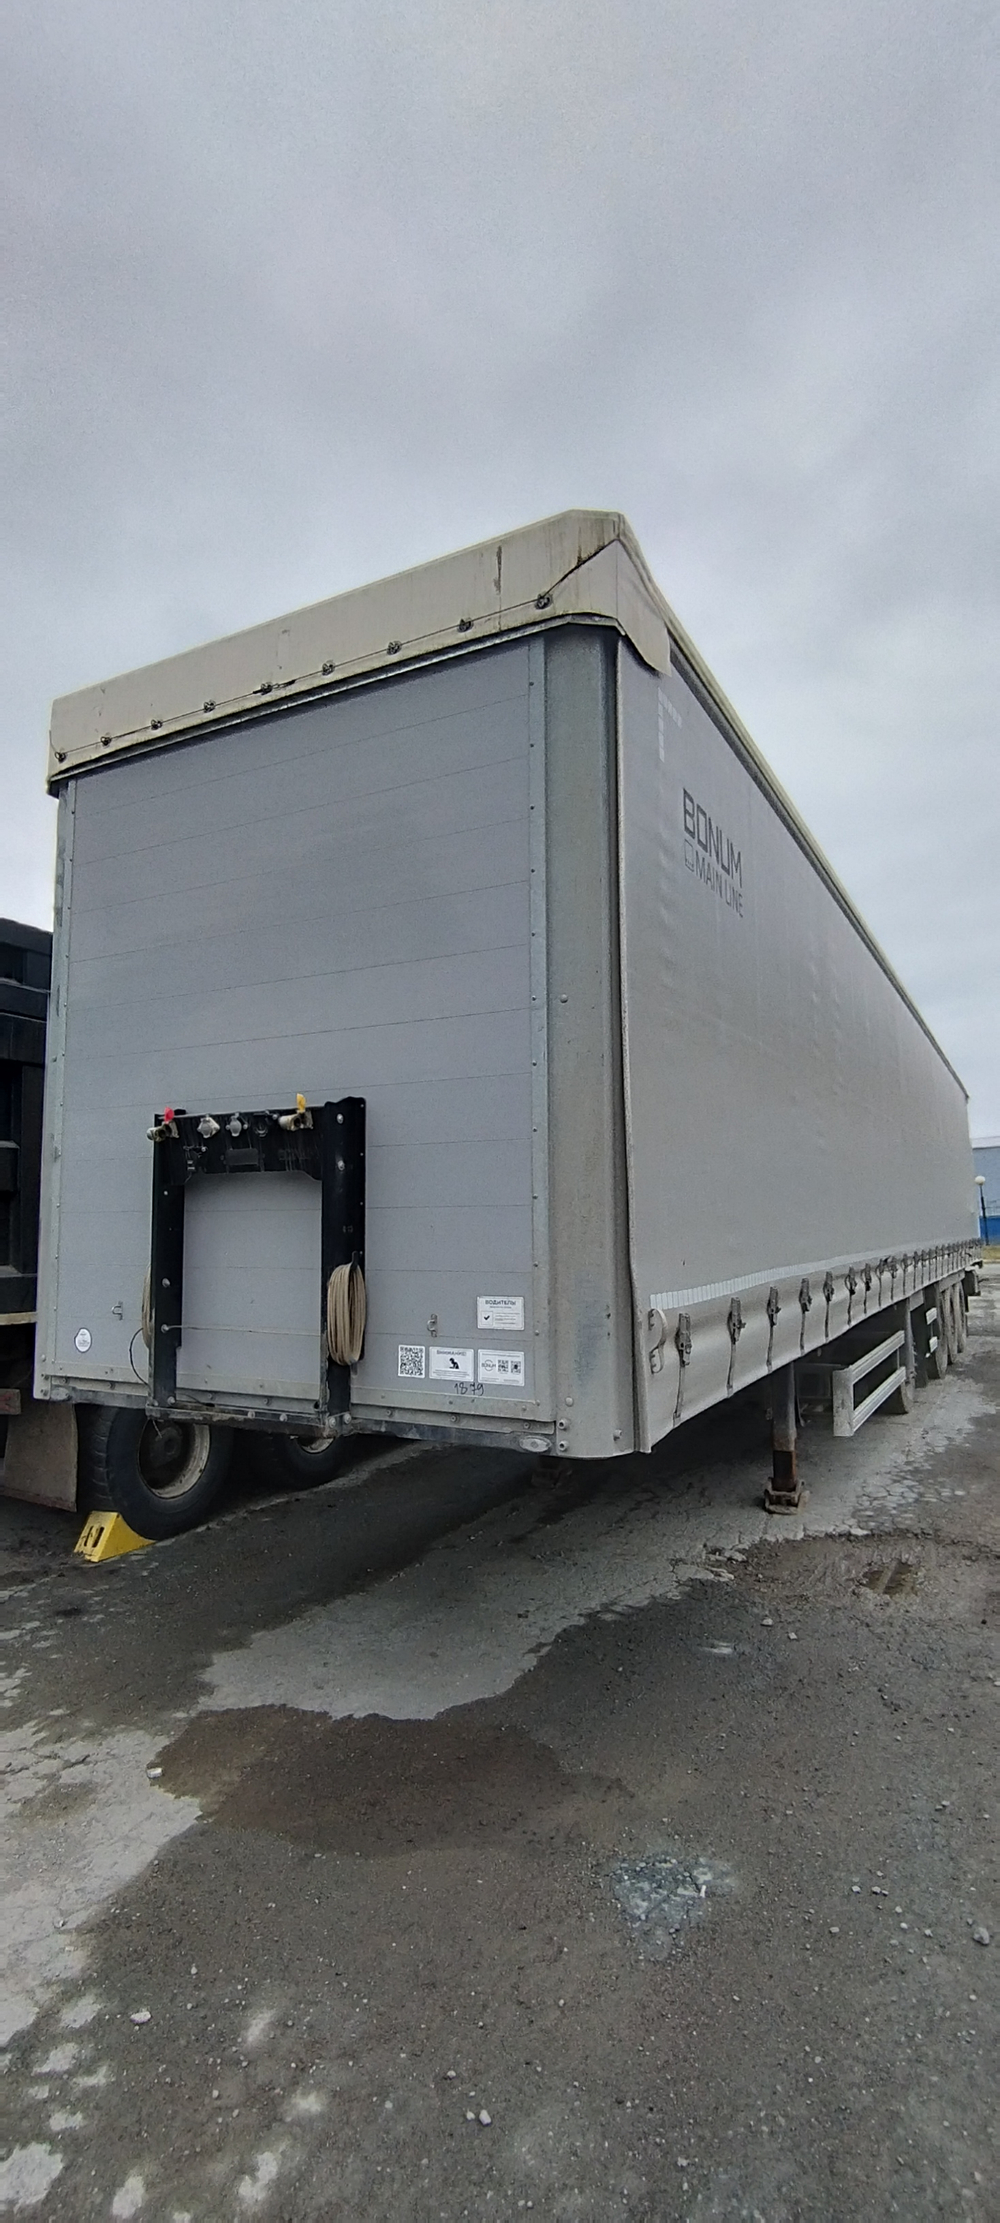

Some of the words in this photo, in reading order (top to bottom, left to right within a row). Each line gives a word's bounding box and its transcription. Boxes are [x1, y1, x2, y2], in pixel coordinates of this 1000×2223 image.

[683, 787, 742, 889] BONUM
[695, 849, 723, 899] MAIN
[725, 878, 743, 918] LINE
